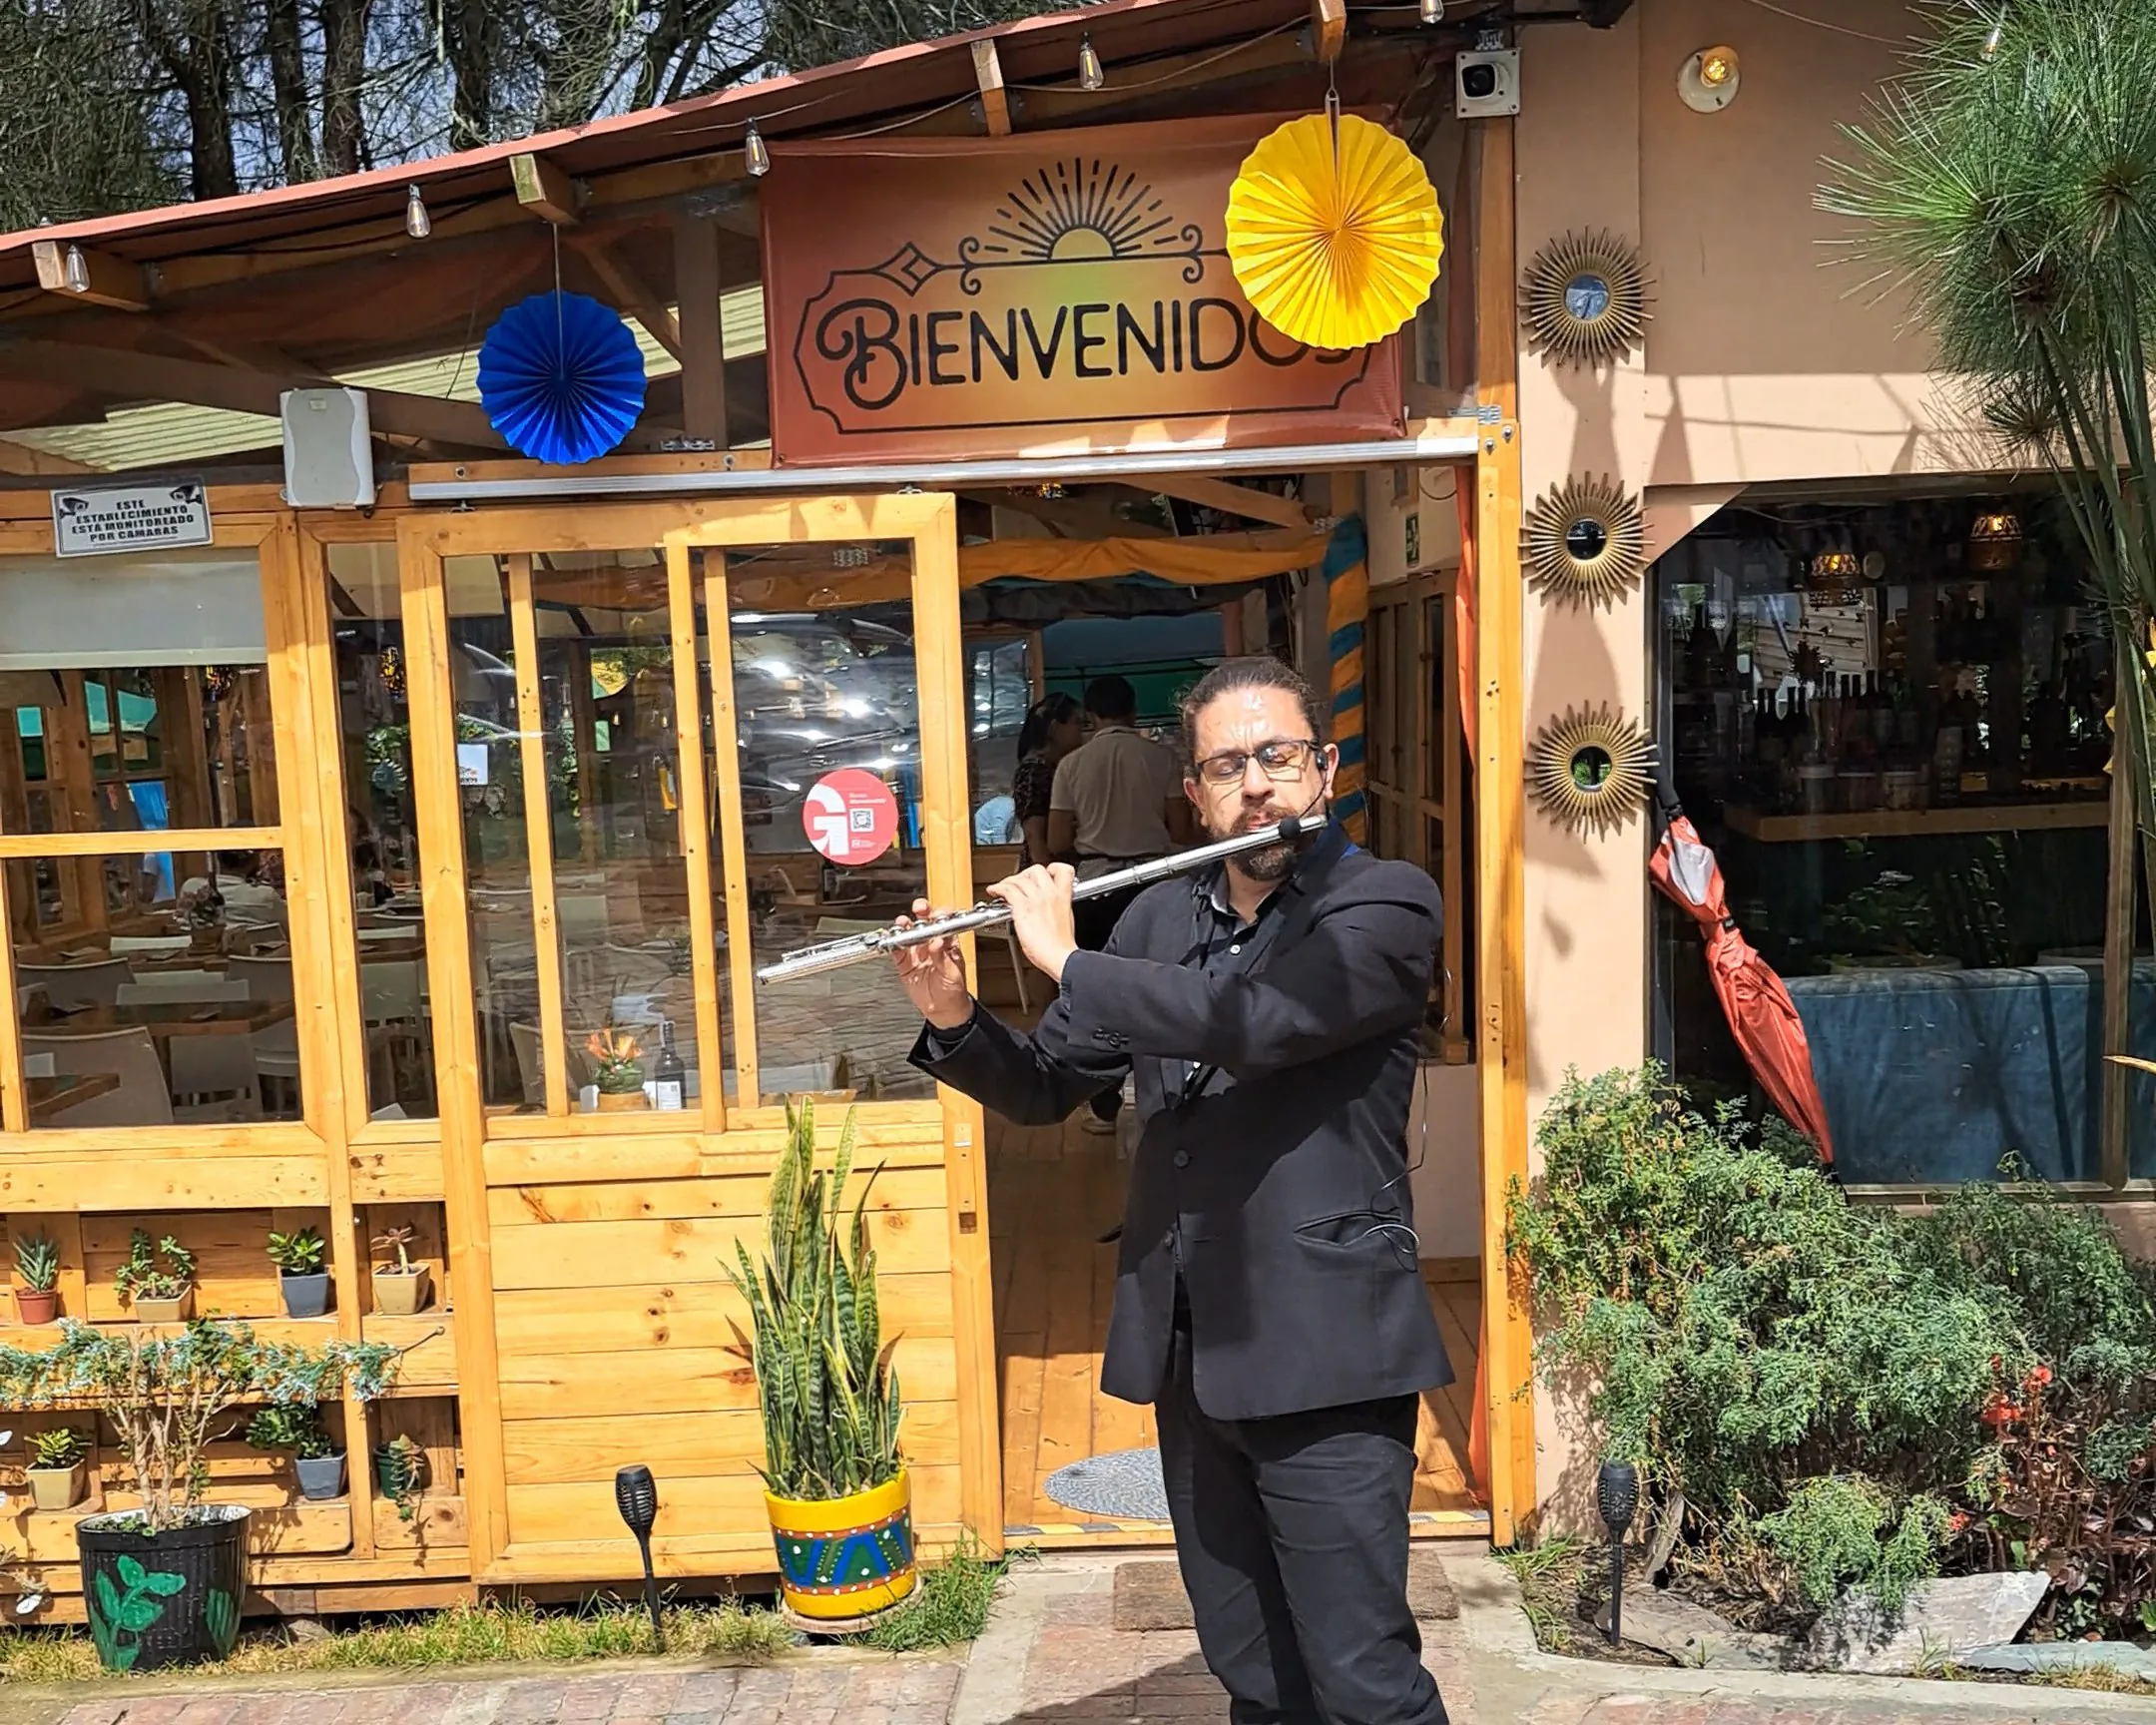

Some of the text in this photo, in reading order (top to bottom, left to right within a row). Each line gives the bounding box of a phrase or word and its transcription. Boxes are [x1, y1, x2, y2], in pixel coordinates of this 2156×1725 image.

[815, 295, 1350, 410] BIENVENIDO
[117, 499, 146, 510] ESTE
[76, 505, 188, 524] ESTABLECIMIENTO
[105, 514, 194, 531] MONITOREADO
[90, 533, 116, 542] POR
